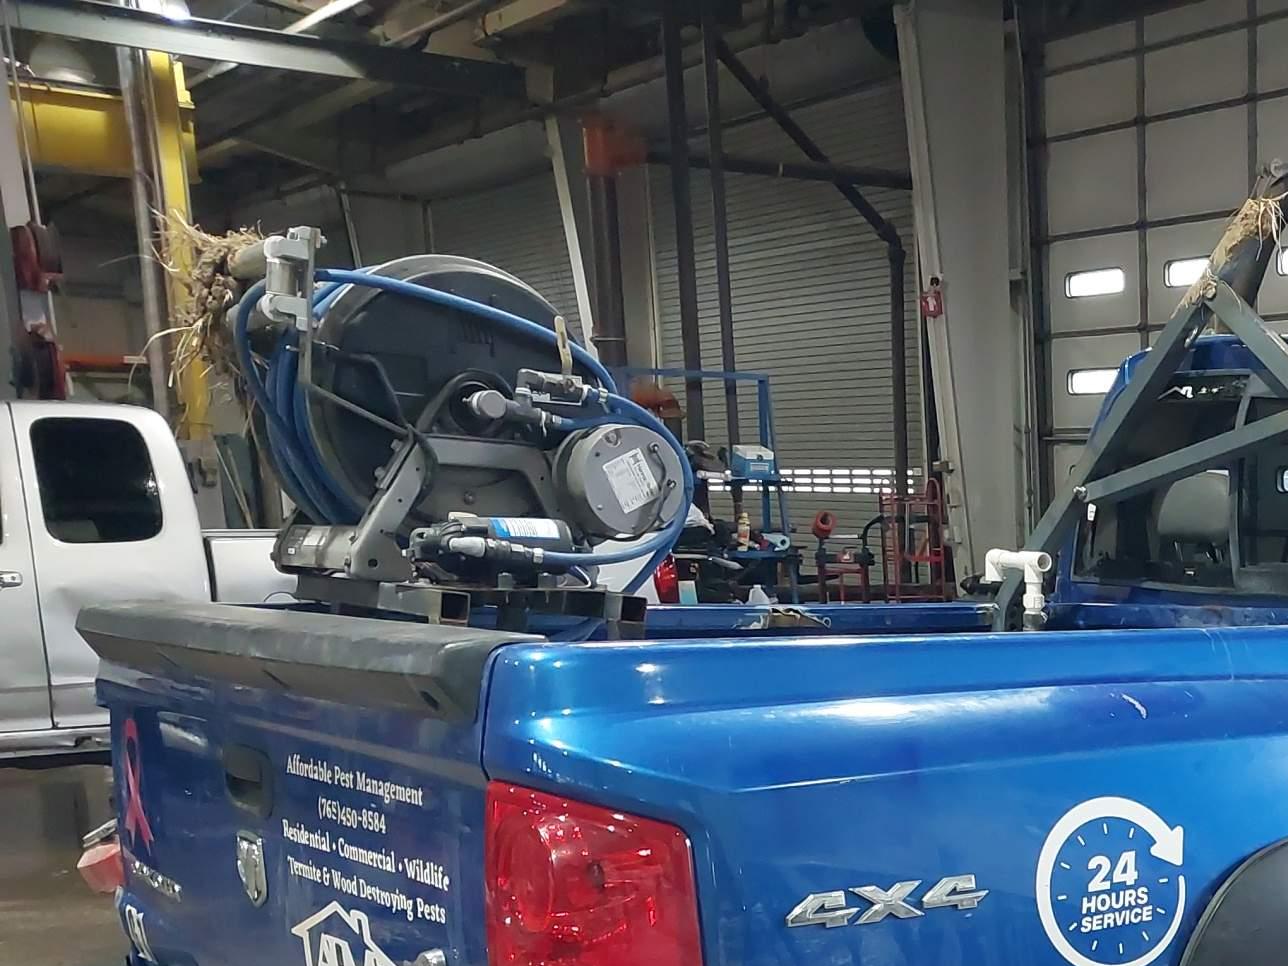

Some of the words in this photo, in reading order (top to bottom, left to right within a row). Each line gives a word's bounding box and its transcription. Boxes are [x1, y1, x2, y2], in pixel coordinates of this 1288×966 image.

[286, 753, 332, 785] Affordable
[334, 765, 354, 790] Pest
[355, 770, 423, 807] Management
[318, 795, 386, 835] (765)450-8584
[282, 818, 331, 853] Residential
[338, 837, 396, 873] Commercial
[403, 857, 450, 892] Wildlife
[1087, 850, 1139, 892] 24
[286, 855, 322, 882] Termite
[322, 866, 331, 887] &
[331, 868, 358, 898] Wood
[358, 875, 414, 922] Destroying
[416, 896, 447, 925] Pests
[1081, 887, 1149, 914] HOURS
[1080, 904, 1153, 933] SERVICE
